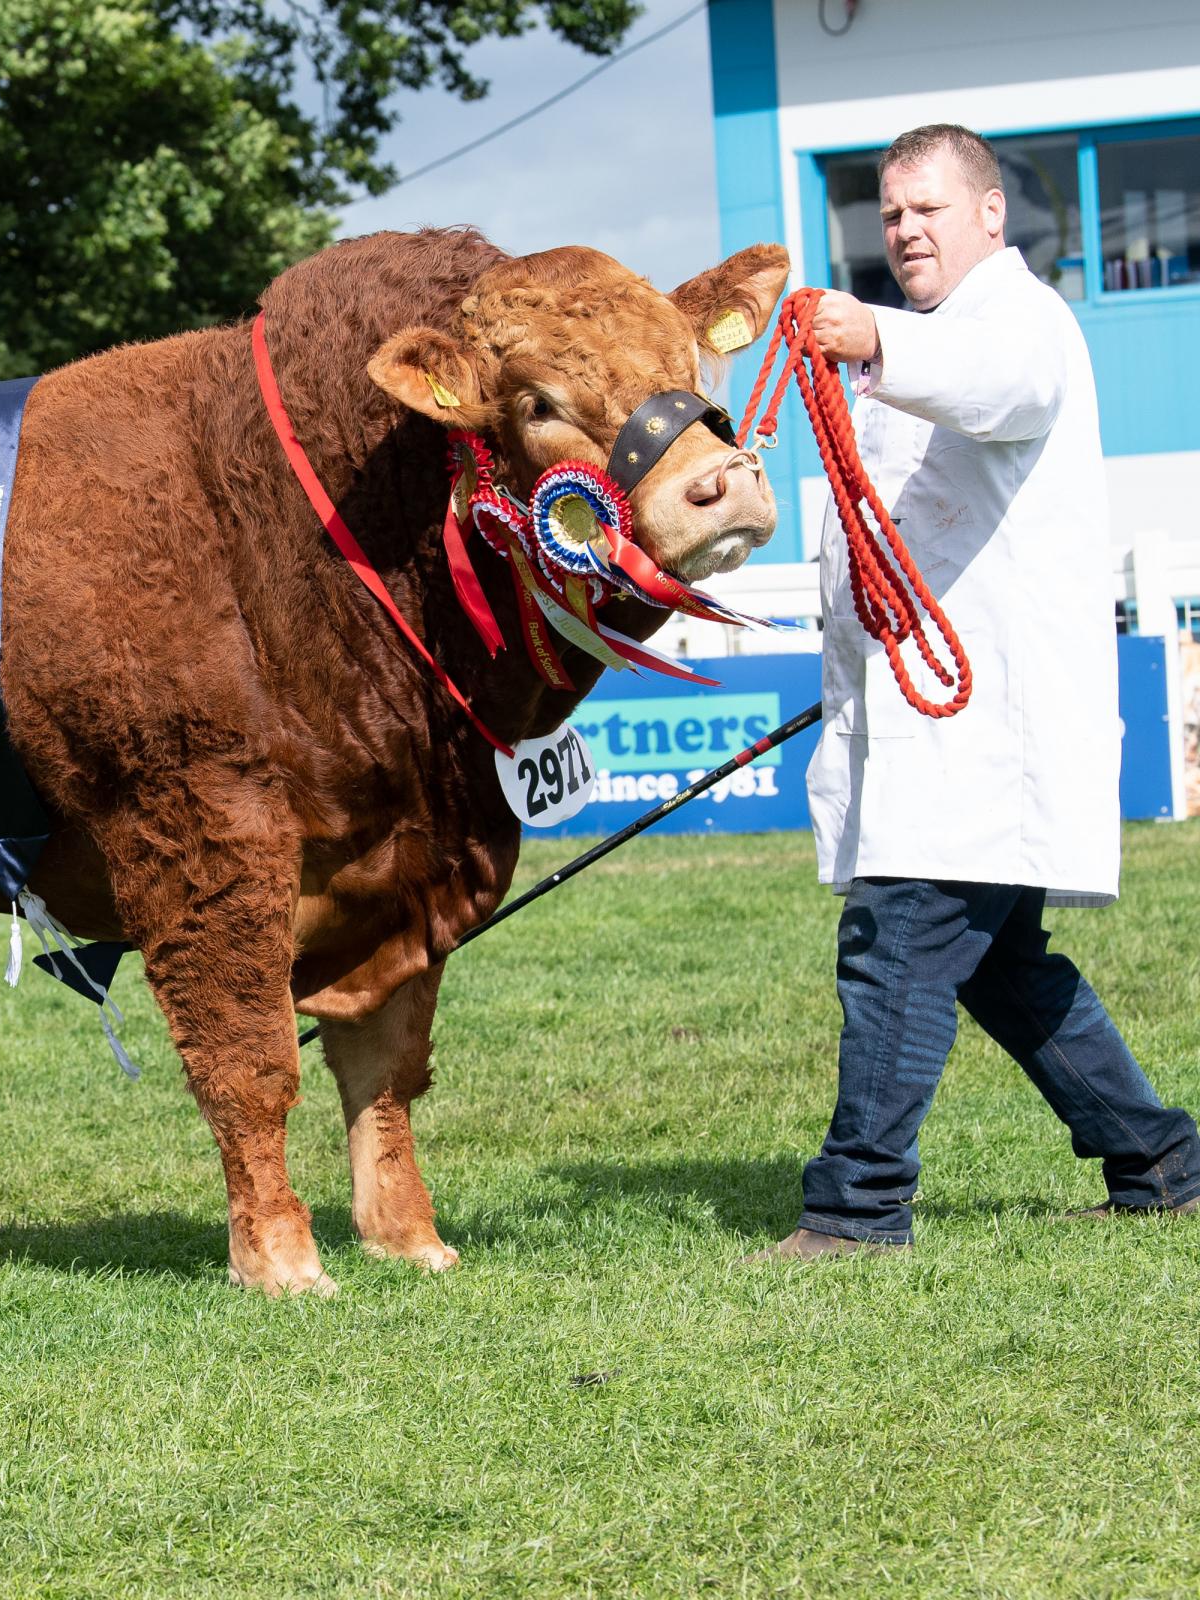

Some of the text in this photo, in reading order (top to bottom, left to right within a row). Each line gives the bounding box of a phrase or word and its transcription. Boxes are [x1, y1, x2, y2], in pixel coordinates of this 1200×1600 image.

[655, 571, 680, 595] Royal
[528, 621, 543, 648] Bank
[536, 646, 549, 661] of
[540, 656, 566, 686] Scotland
[517, 728, 591, 818] 2977
[686, 765, 779, 803] 1981
